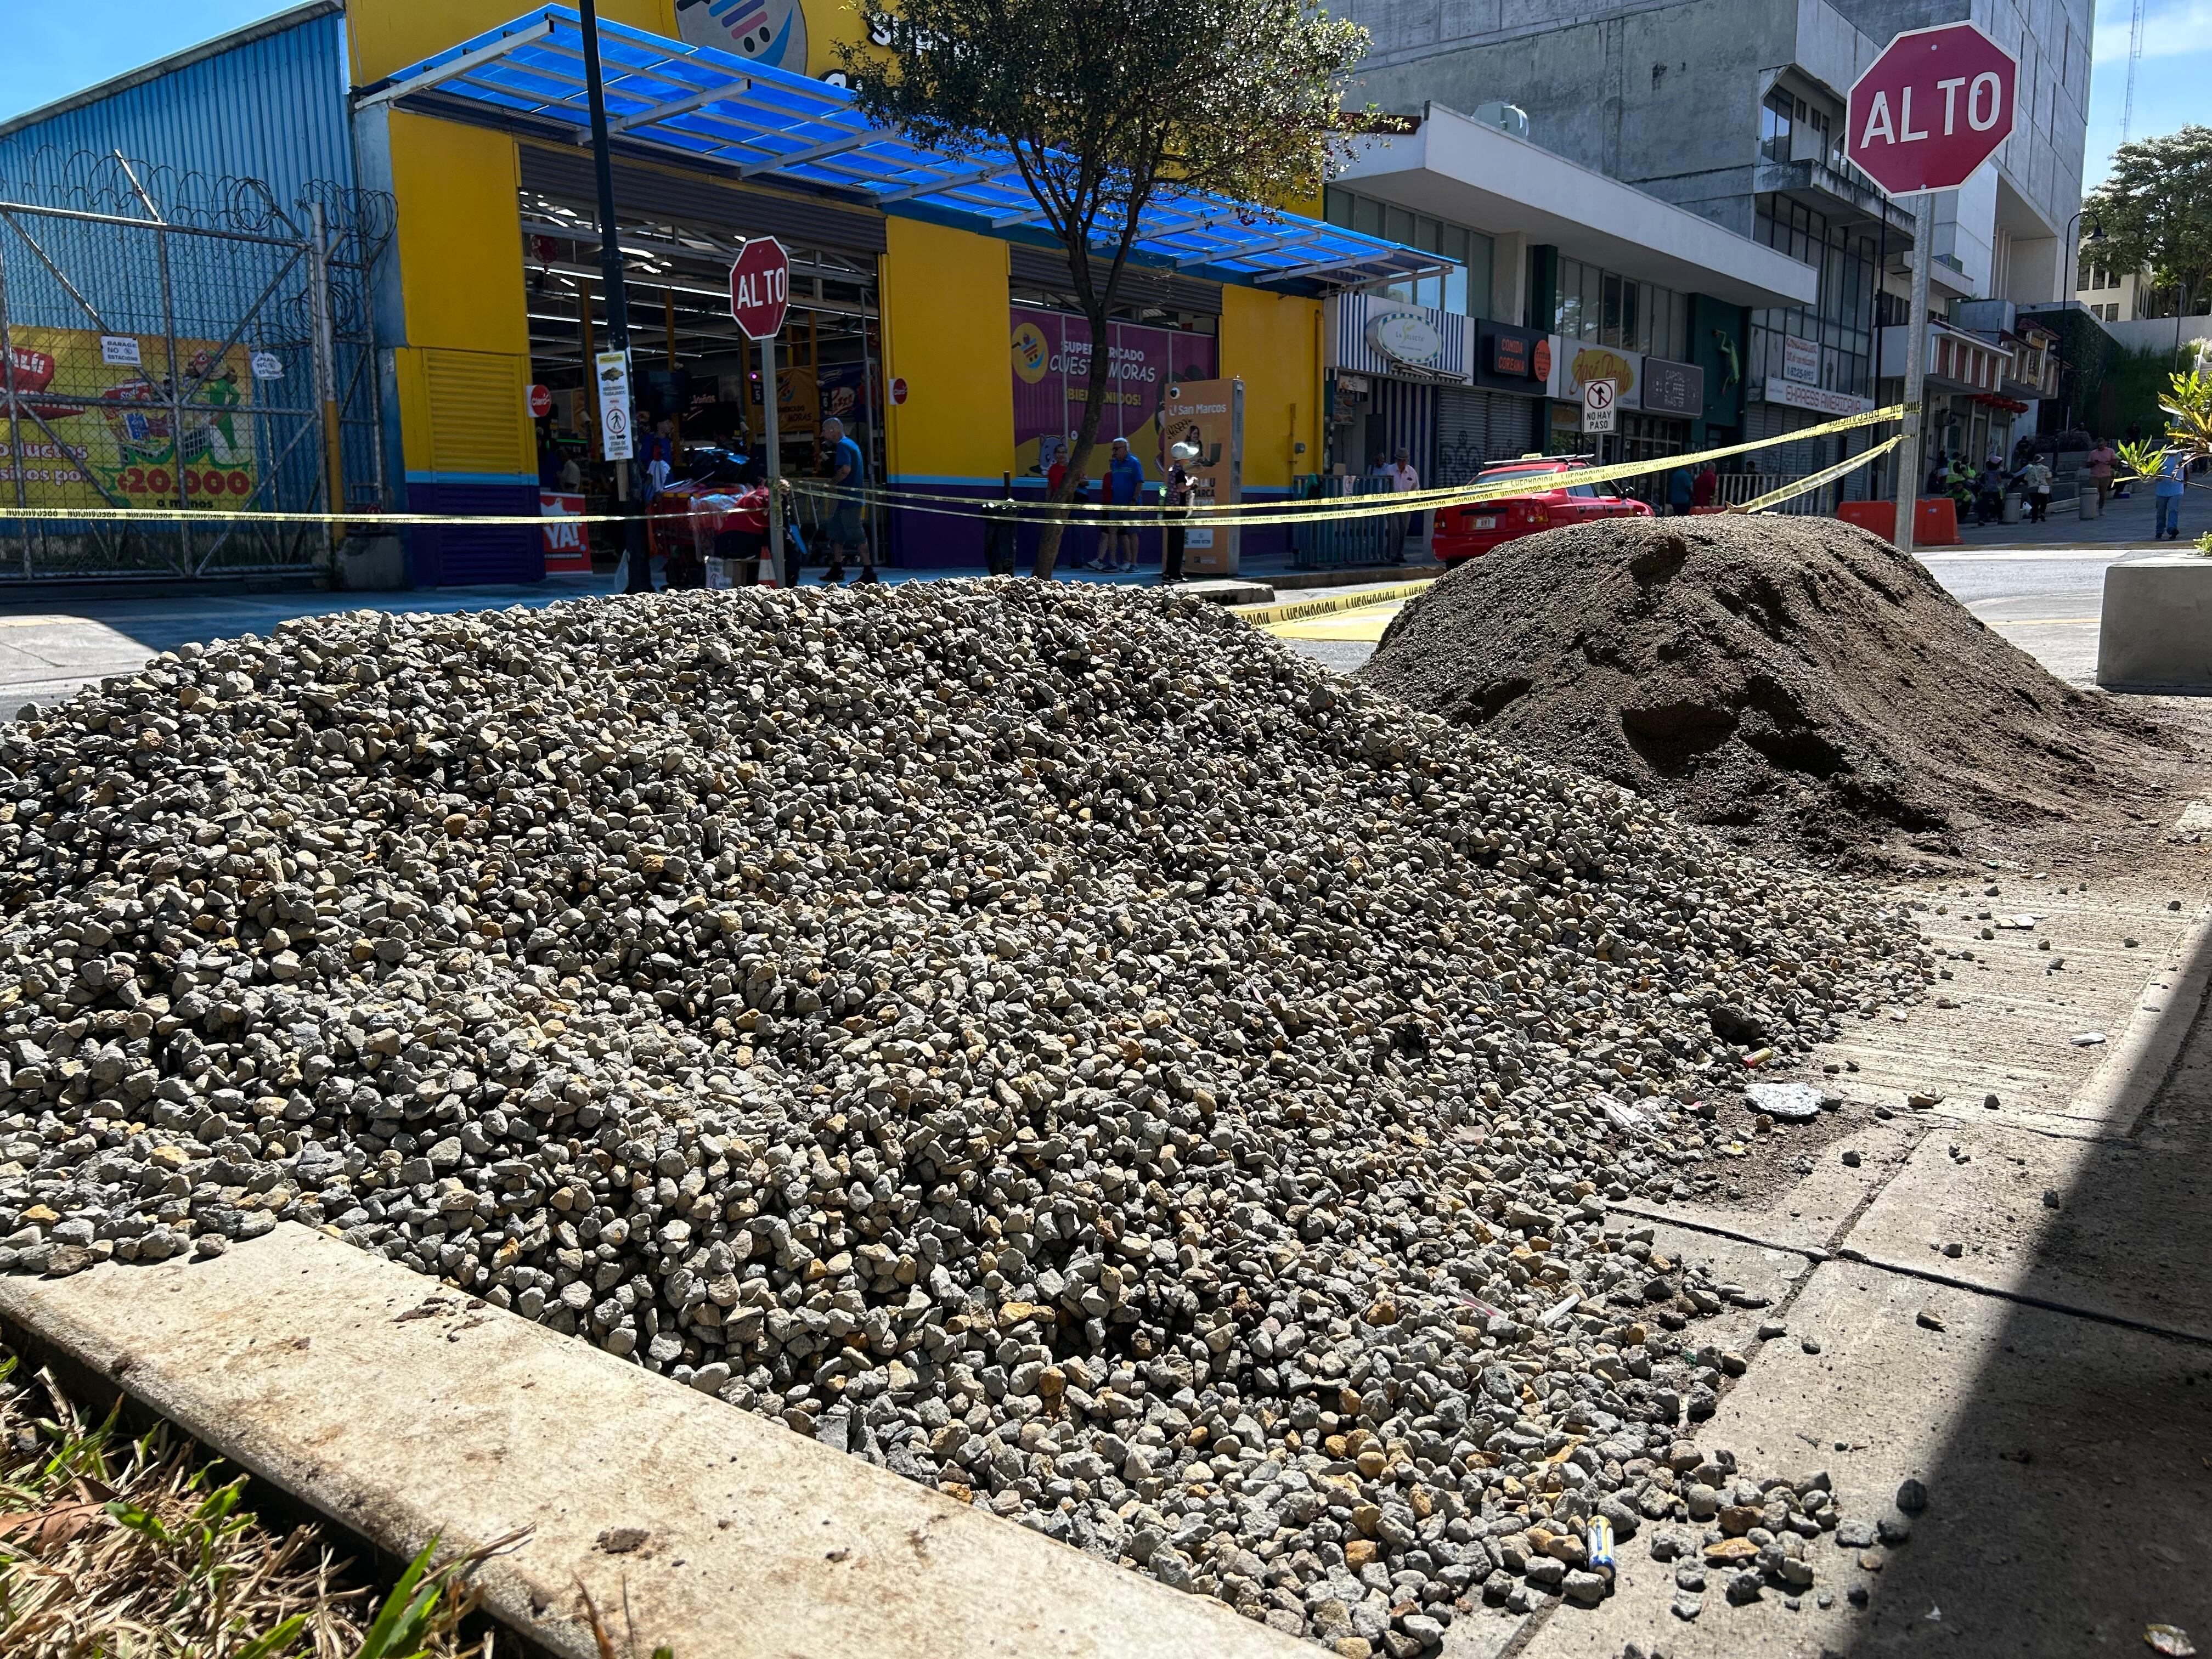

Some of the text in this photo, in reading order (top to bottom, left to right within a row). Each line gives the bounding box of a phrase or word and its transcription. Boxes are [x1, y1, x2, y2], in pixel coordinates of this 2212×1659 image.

[1859, 71, 2001, 149] ALTO
[737, 267, 786, 310] ALTO
[106, 341, 137, 349] GARAGE
[1502, 338, 1523, 354] COMIDA
[1108, 362, 1155, 382] MORAS
[1498, 356, 1525, 373] COREANA
[754, 390, 761, 401] 5
[1786, 385, 1819, 407] EXPRESS
[1820, 393, 1861, 414] AMERICANA
[1178, 405, 1194, 415] San
[1195, 403, 1227, 415] Marcos
[1587, 410, 1612, 421] NO HAY
[1589, 420, 1609, 430] PASO
[170, 500, 213, 510] mnos
[543, 521, 580, 550] YA!
